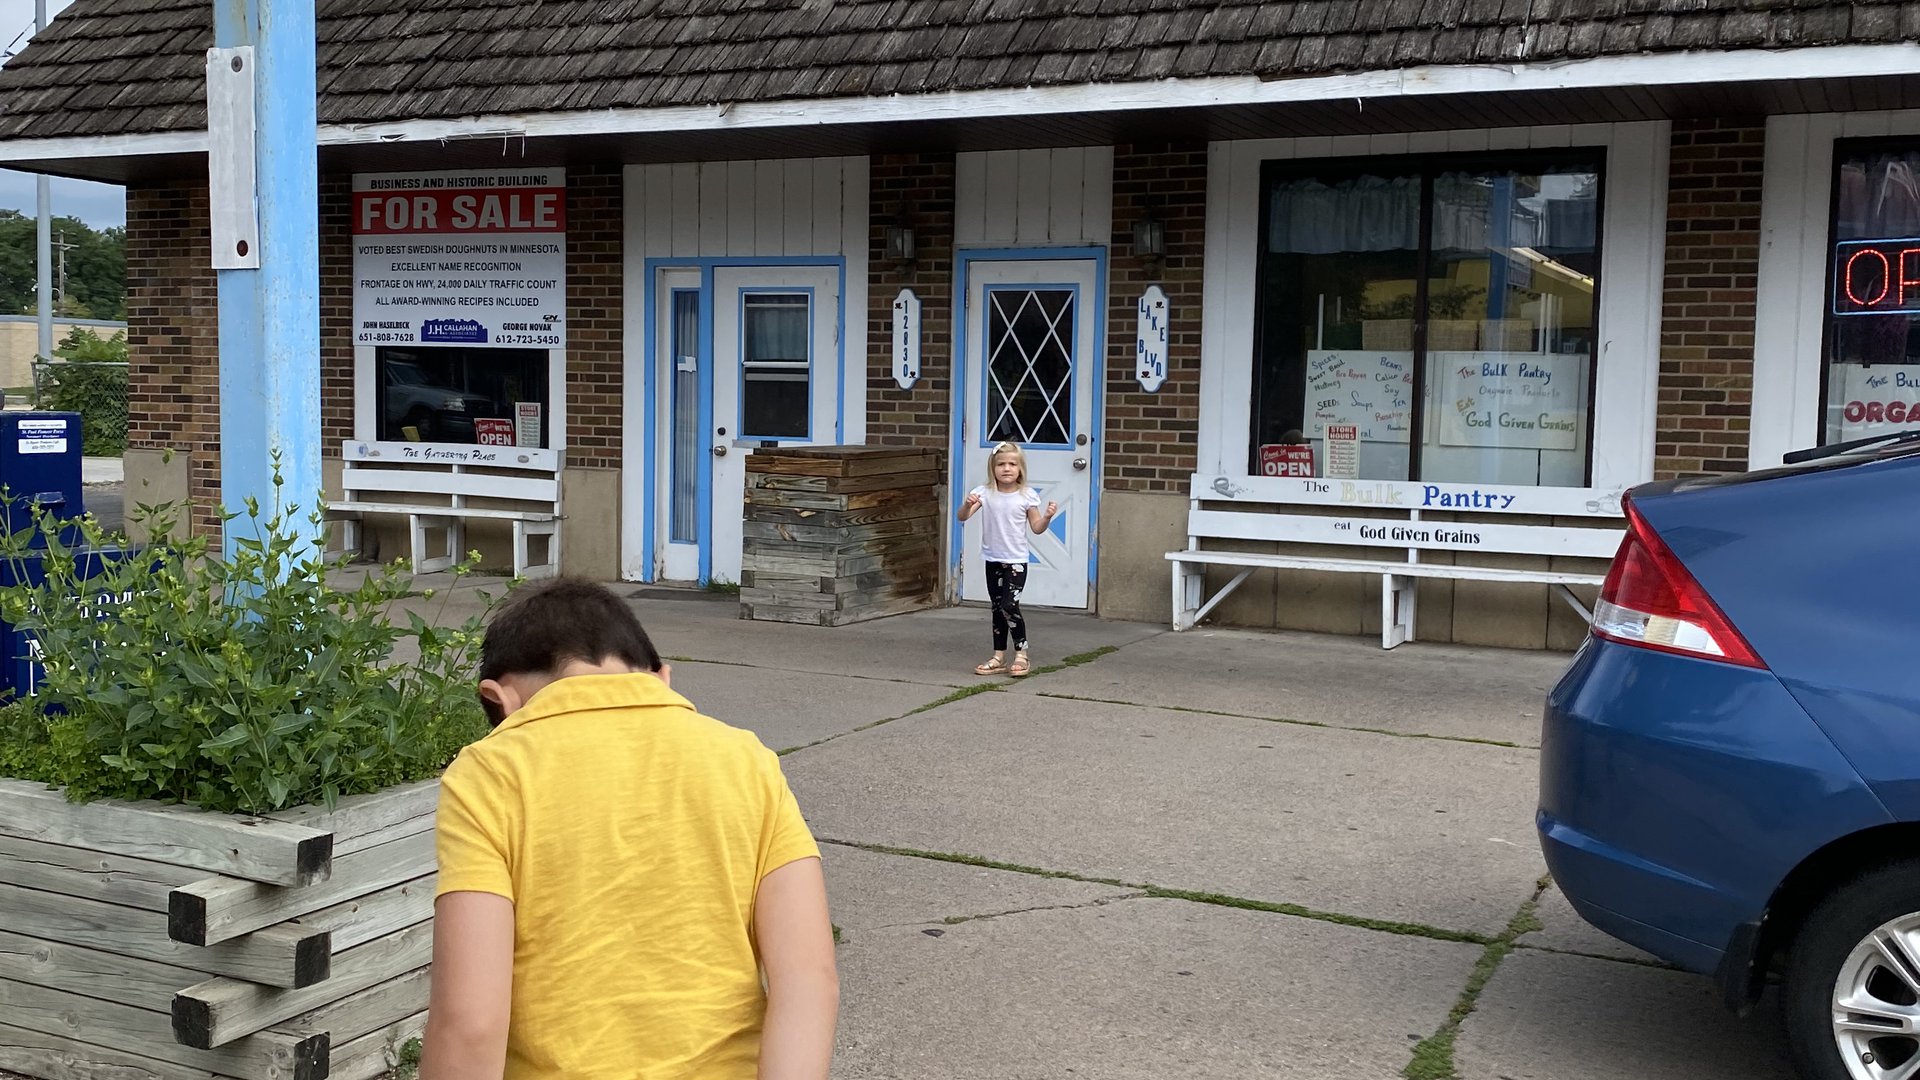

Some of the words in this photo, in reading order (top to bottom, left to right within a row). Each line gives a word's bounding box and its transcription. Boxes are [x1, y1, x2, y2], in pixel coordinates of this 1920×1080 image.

[370, 178, 420, 189] BUSINESS
[423, 178, 444, 188] AND
[447, 176, 494, 188] HISTORIC
[498, 176, 548, 186] BUILDING
[362, 196, 438, 230] FOR
[452, 194, 558, 228] SALE
[358, 246, 384, 254] VOTED
[386, 246, 406, 254] BEST
[408, 245, 444, 254] SWEDISH
[446, 245, 498, 254] DOUGHNUTS
[500, 245, 508, 253] IN
[510, 245, 559, 253] MINNESOTA
[392, 262, 436, 271] EXCELLENT
[438, 262, 462, 271] NAME
[464, 262, 521, 271] RECOGNITION
[360, 280, 400, 289] FRONTAGE
[402, 280, 414, 289] ON
[437, 280, 462, 290] 24,000
[464, 280, 487, 289] DAILY
[489, 280, 524, 289] TRAFFIC
[527, 280, 557, 289] COUNT
[376, 297, 390, 306] ALL
[391, 297, 456, 306] AWARD-WINNING
[459, 297, 494, 306] RECIPES
[496, 298, 539, 306] INCLUDED
[1140, 298, 1165, 342] LAKE
[428, 324, 445, 334] J.H.
[359, 333, 414, 341] 651-808-7628
[496, 335, 559, 344] 612-723-5450
[1384, 384, 1399, 396] Soy
[480, 433, 512, 445] OPEN
[1265, 462, 1311, 476] OPEN
[1303, 480, 1329, 494] The
[1340, 480, 1403, 505] Bulk
[1422, 485, 1516, 509] Pantry
[1334, 522, 1351, 530] eat
[1359, 525, 1386, 540] God
[1391, 526, 1429, 543] Given
[1434, 528, 1480, 545] Grains
